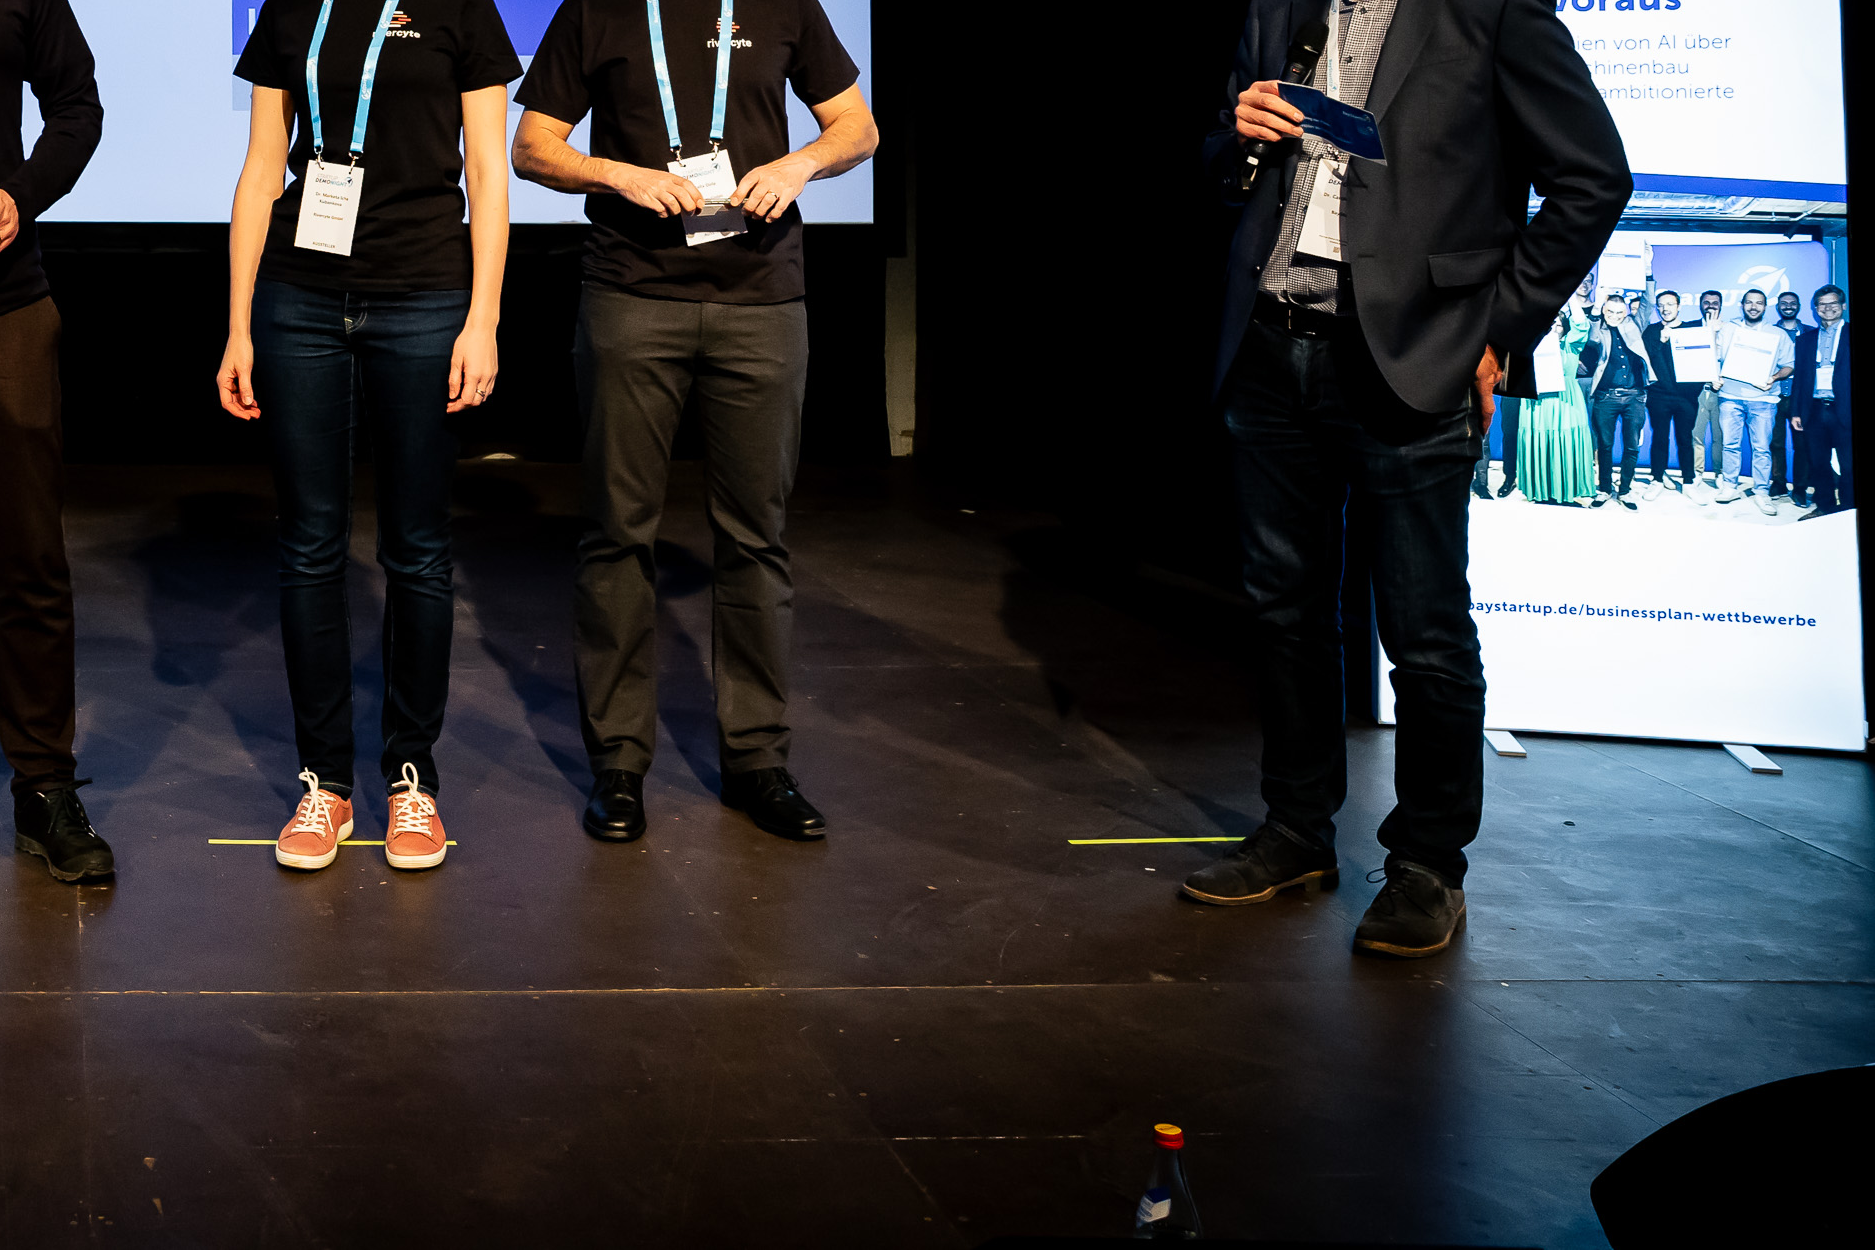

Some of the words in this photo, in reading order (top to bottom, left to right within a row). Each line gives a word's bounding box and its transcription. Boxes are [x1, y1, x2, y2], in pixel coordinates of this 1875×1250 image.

[706, 38, 753, 49] rivcyte
[1613, 38, 1650, 50] von
[1684, 33, 1732, 50] über
